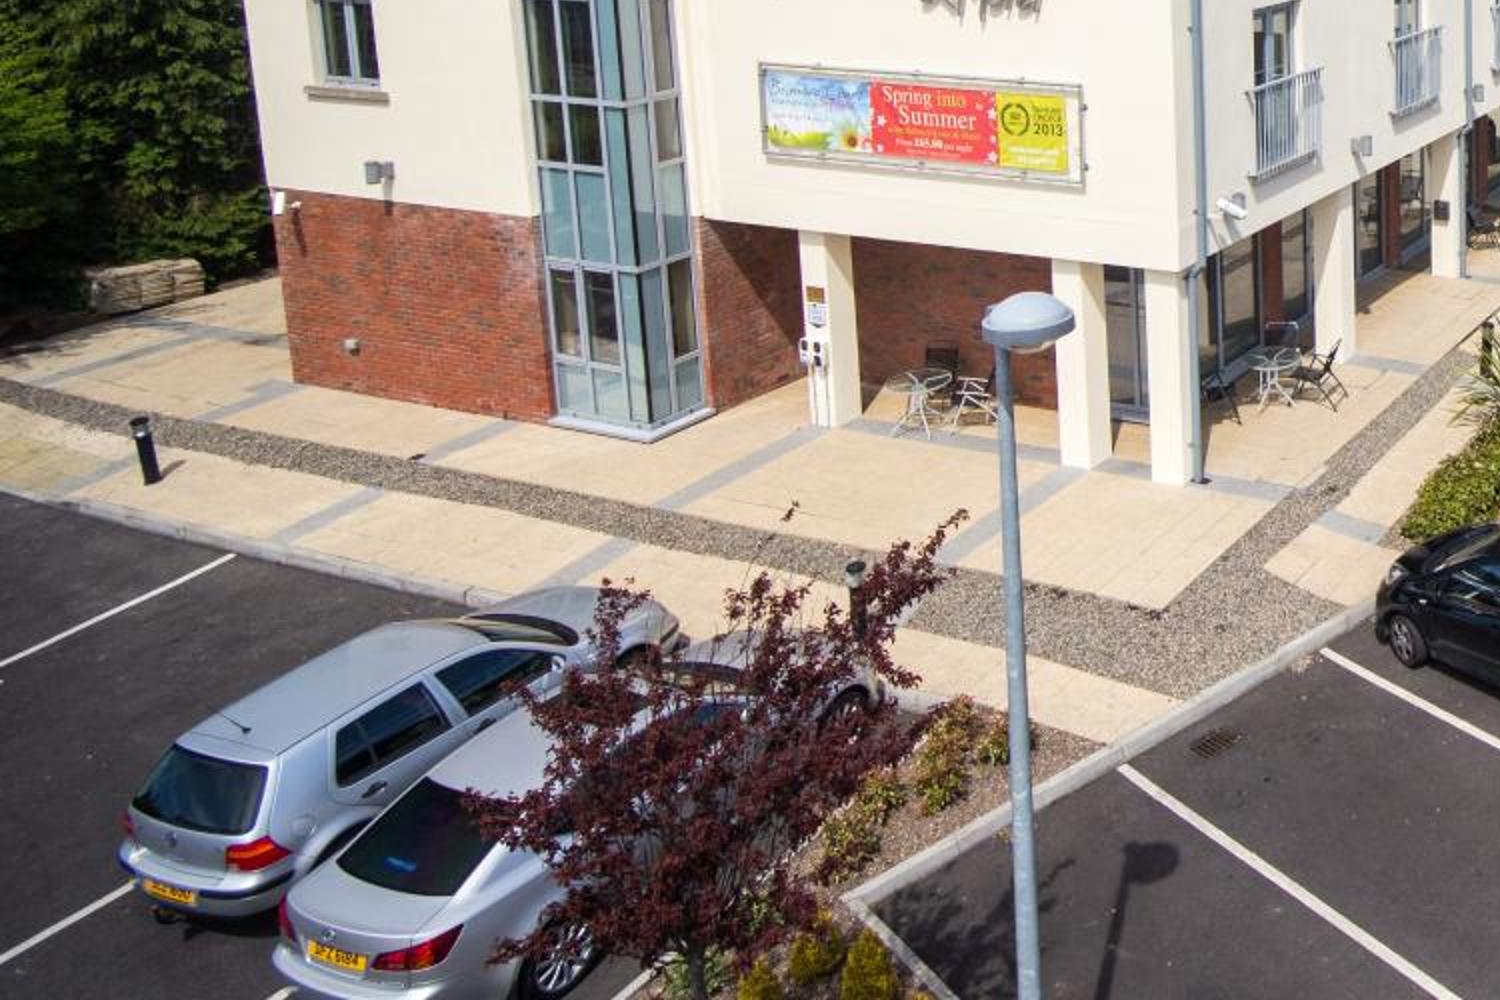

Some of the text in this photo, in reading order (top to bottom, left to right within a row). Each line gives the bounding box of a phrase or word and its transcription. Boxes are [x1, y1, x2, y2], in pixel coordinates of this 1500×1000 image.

[882, 85, 933, 111] Spring
[936, 90, 967, 109] into
[898, 105, 977, 131] Summer
[1033, 123, 1064, 137] 2013
